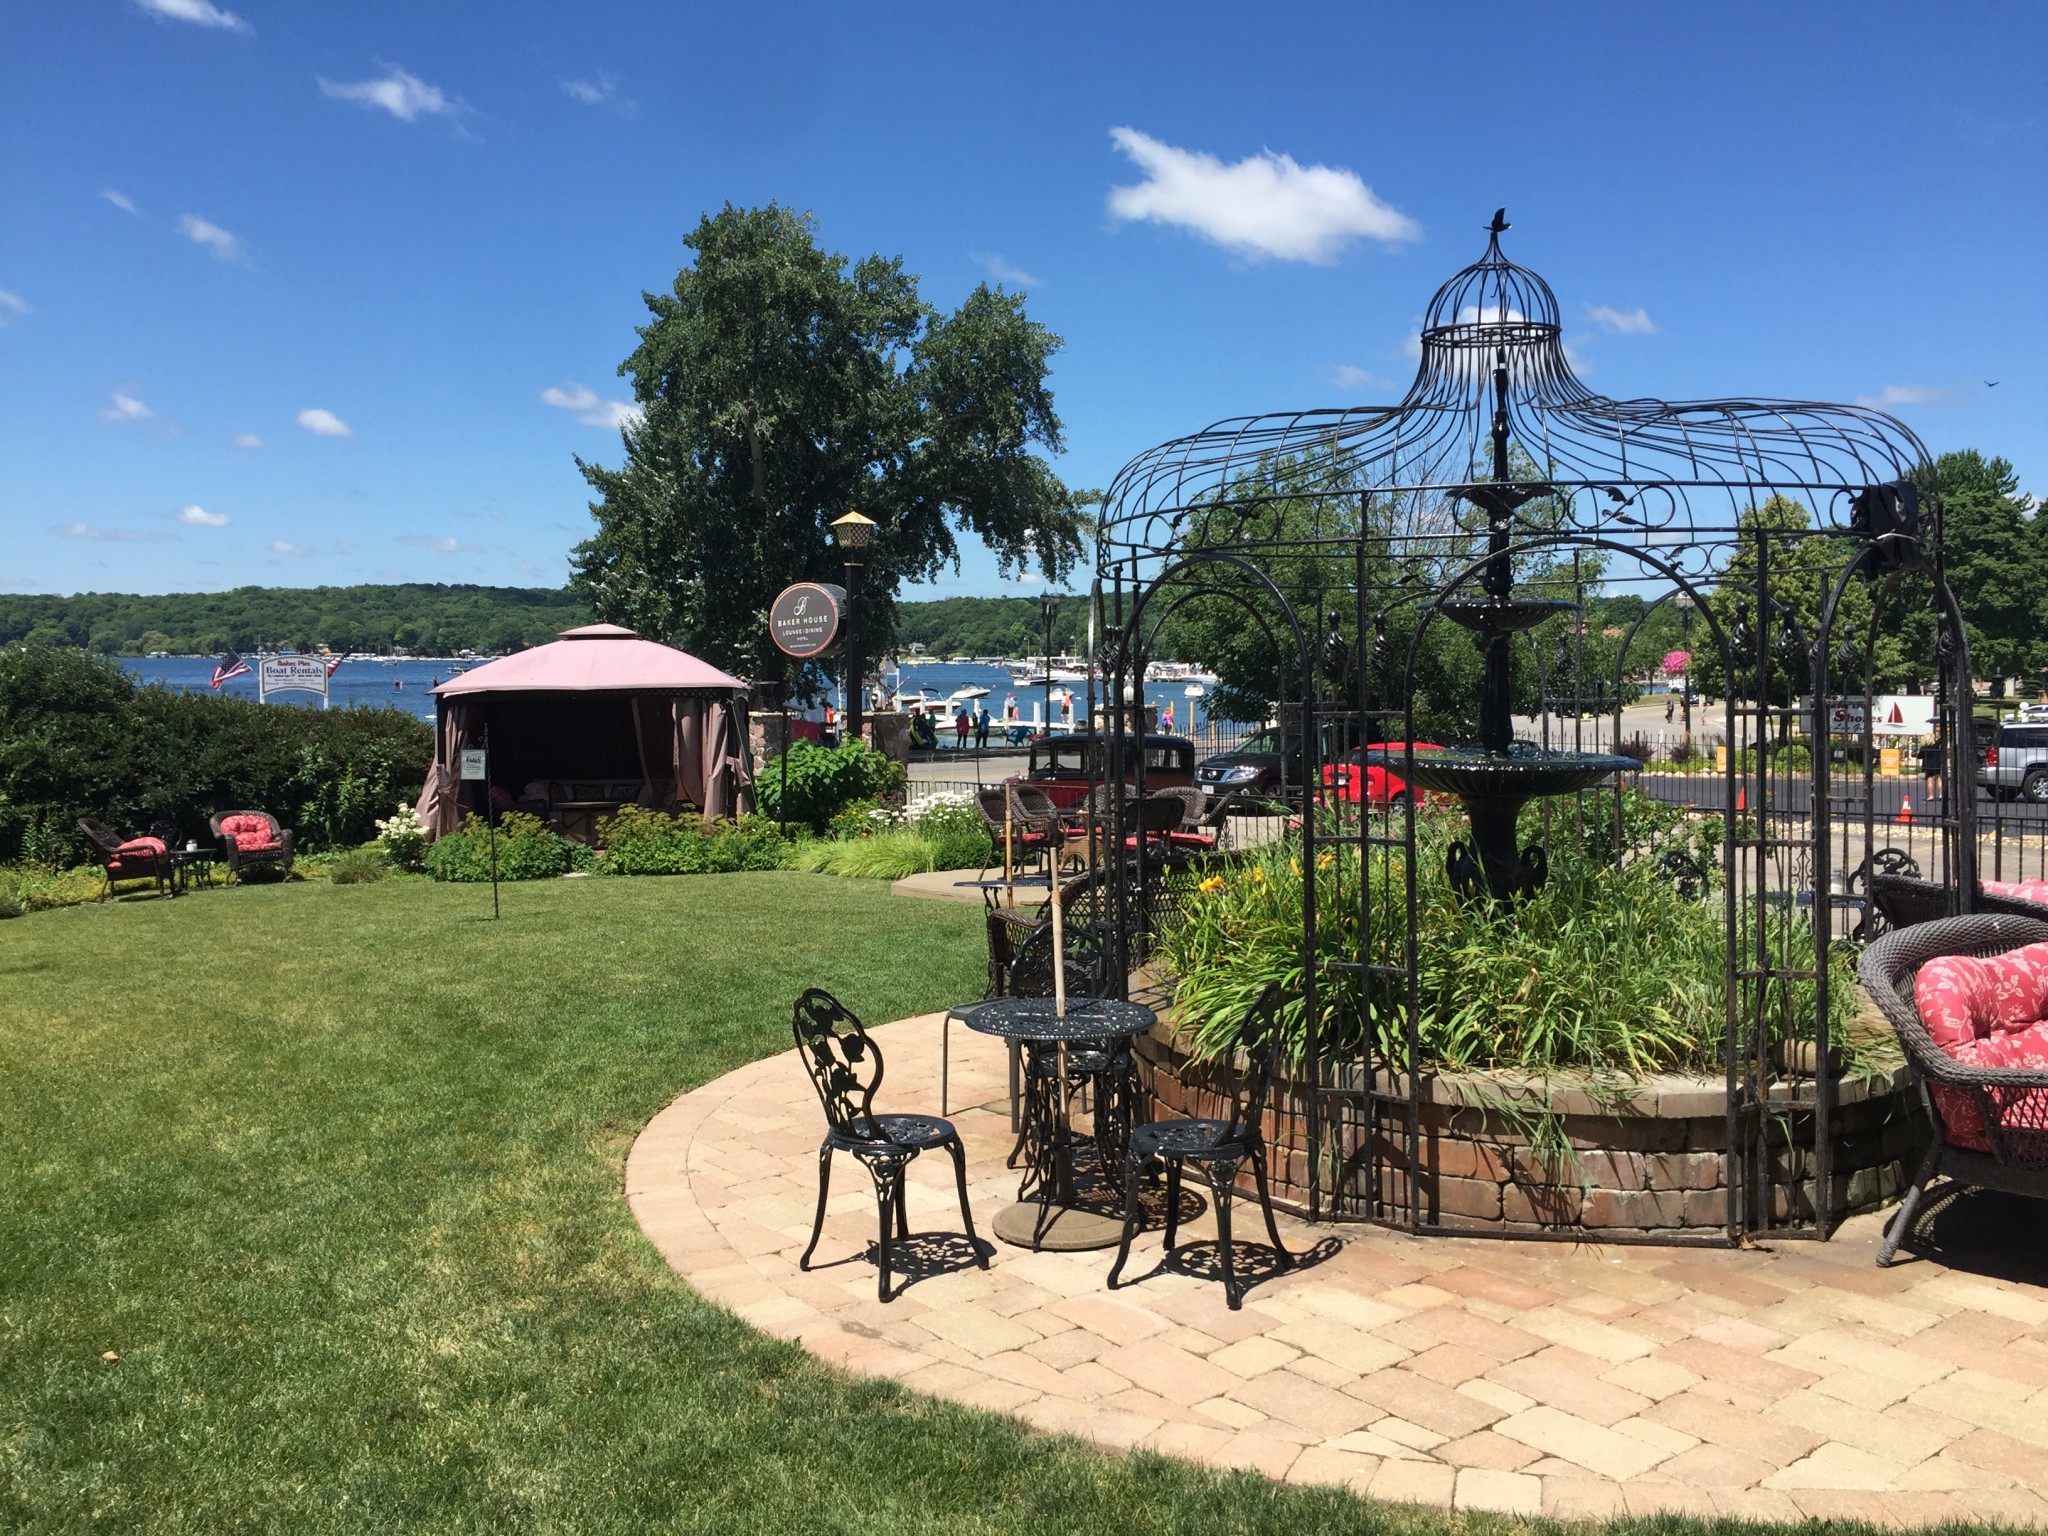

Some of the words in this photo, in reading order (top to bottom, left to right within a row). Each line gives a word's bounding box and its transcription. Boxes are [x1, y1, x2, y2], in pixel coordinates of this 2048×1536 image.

[778, 618, 800, 627] BAKER
[804, 616, 828, 624] HOUSE
[1833, 708, 1884, 722] Shoes
